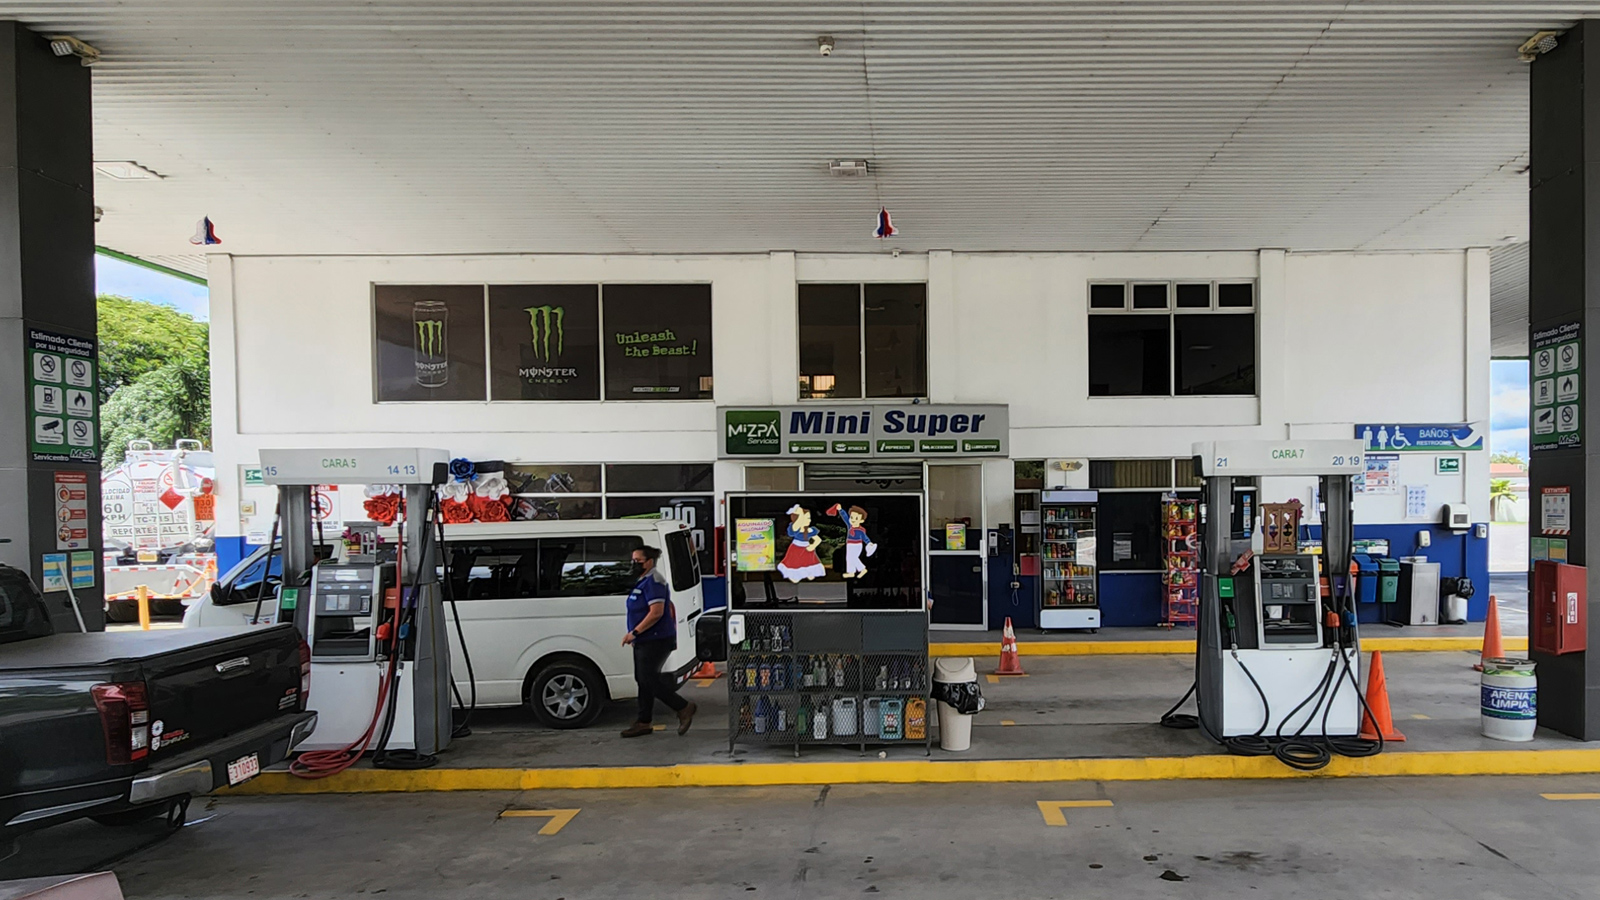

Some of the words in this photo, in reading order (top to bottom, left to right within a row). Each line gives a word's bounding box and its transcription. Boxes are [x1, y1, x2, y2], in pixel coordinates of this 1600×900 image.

[1559, 322, 1580, 334] Cliente
[30, 330, 66, 345] Estimado
[66, 337, 93, 350] Cliente
[616, 329, 676, 344] Unleash
[57, 346, 90, 356] seguridad
[625, 346, 650, 357] the
[652, 339, 697, 356] Beast!
[519, 366, 578, 378] MONSTER
[789, 411, 870, 434] Mini
[883, 410, 986, 436] Super
[1419, 427, 1449, 439] BAÑOS
[33, 453, 70, 461] Servicentro
[1272, 449, 1298, 459] CARA
[1299, 449, 1305, 459] 7
[322, 458, 349, 468] CARA
[350, 458, 357, 468] 5
[1216, 457, 1228, 467] 21
[1332, 456, 1344, 466] 20
[1348, 456, 1360, 466] 19
[264, 466, 278, 476] 15
[387, 465, 400, 475] 14
[403, 465, 416, 475] 13
[103, 503, 123, 514] 60
[162, 525, 174, 533] AL
[1491, 690, 1530, 700] ARENA
[1491, 698, 1530, 709] LIMPIA
